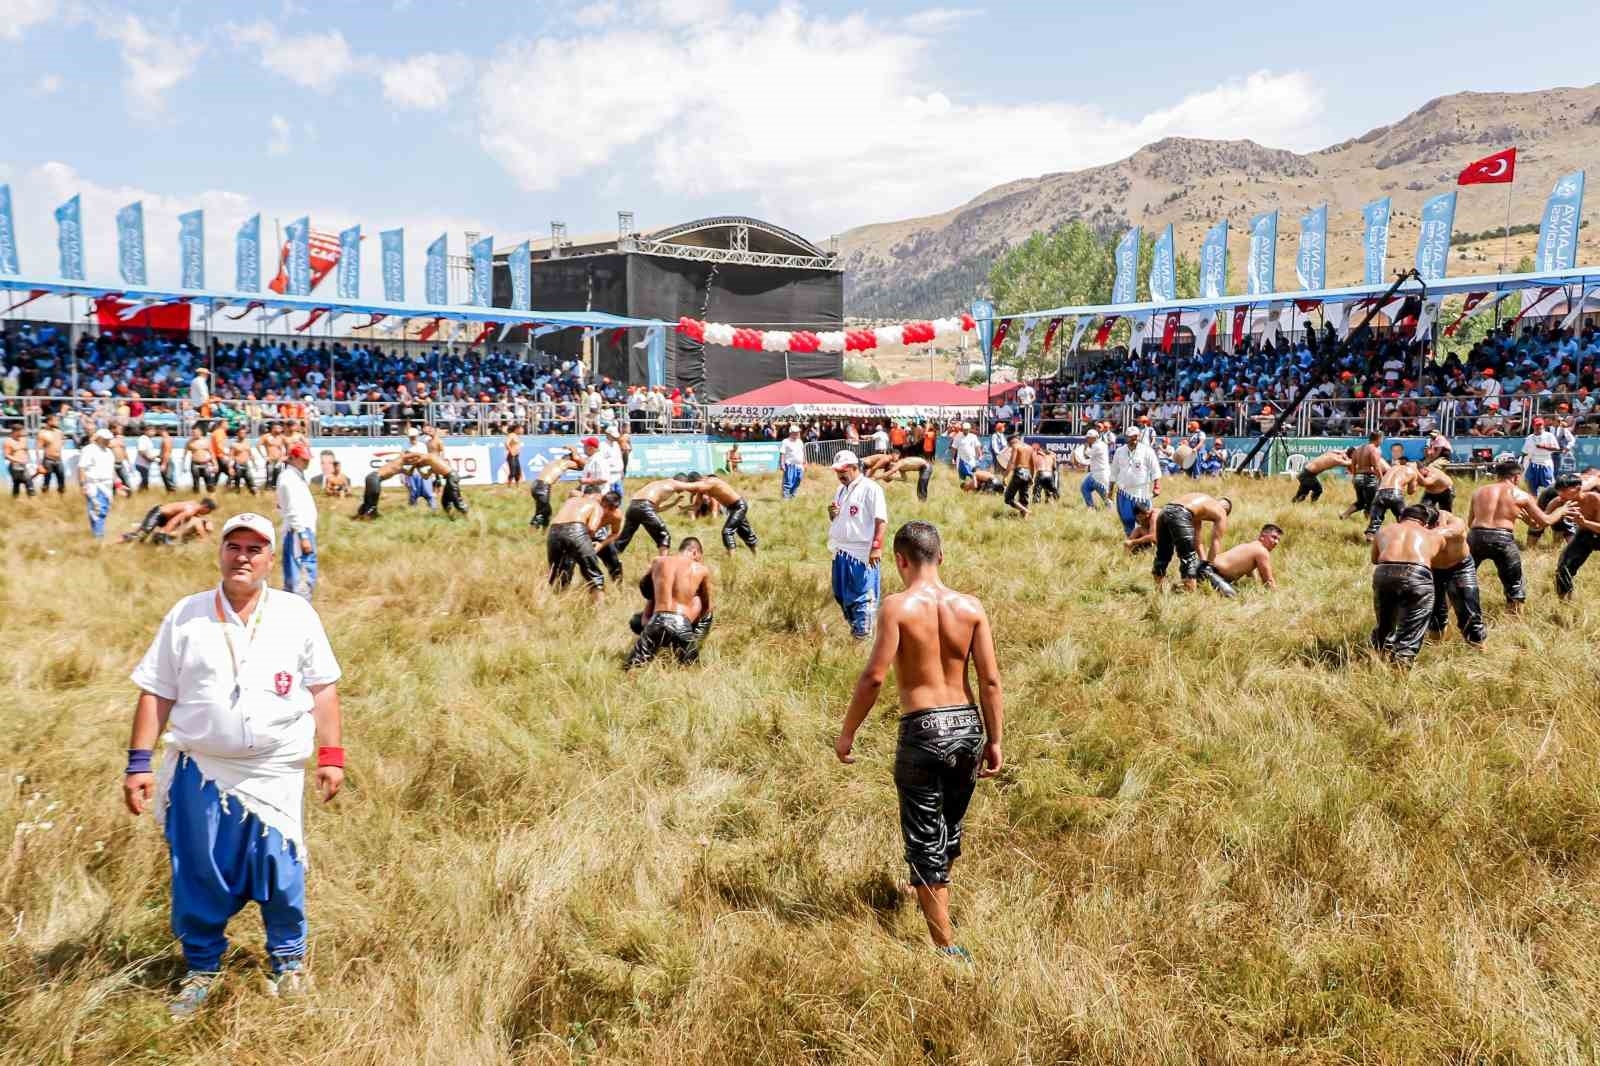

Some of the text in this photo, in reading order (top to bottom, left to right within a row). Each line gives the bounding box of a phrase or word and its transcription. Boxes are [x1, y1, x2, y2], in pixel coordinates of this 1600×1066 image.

[723, 406, 775, 416] 444 82 07
